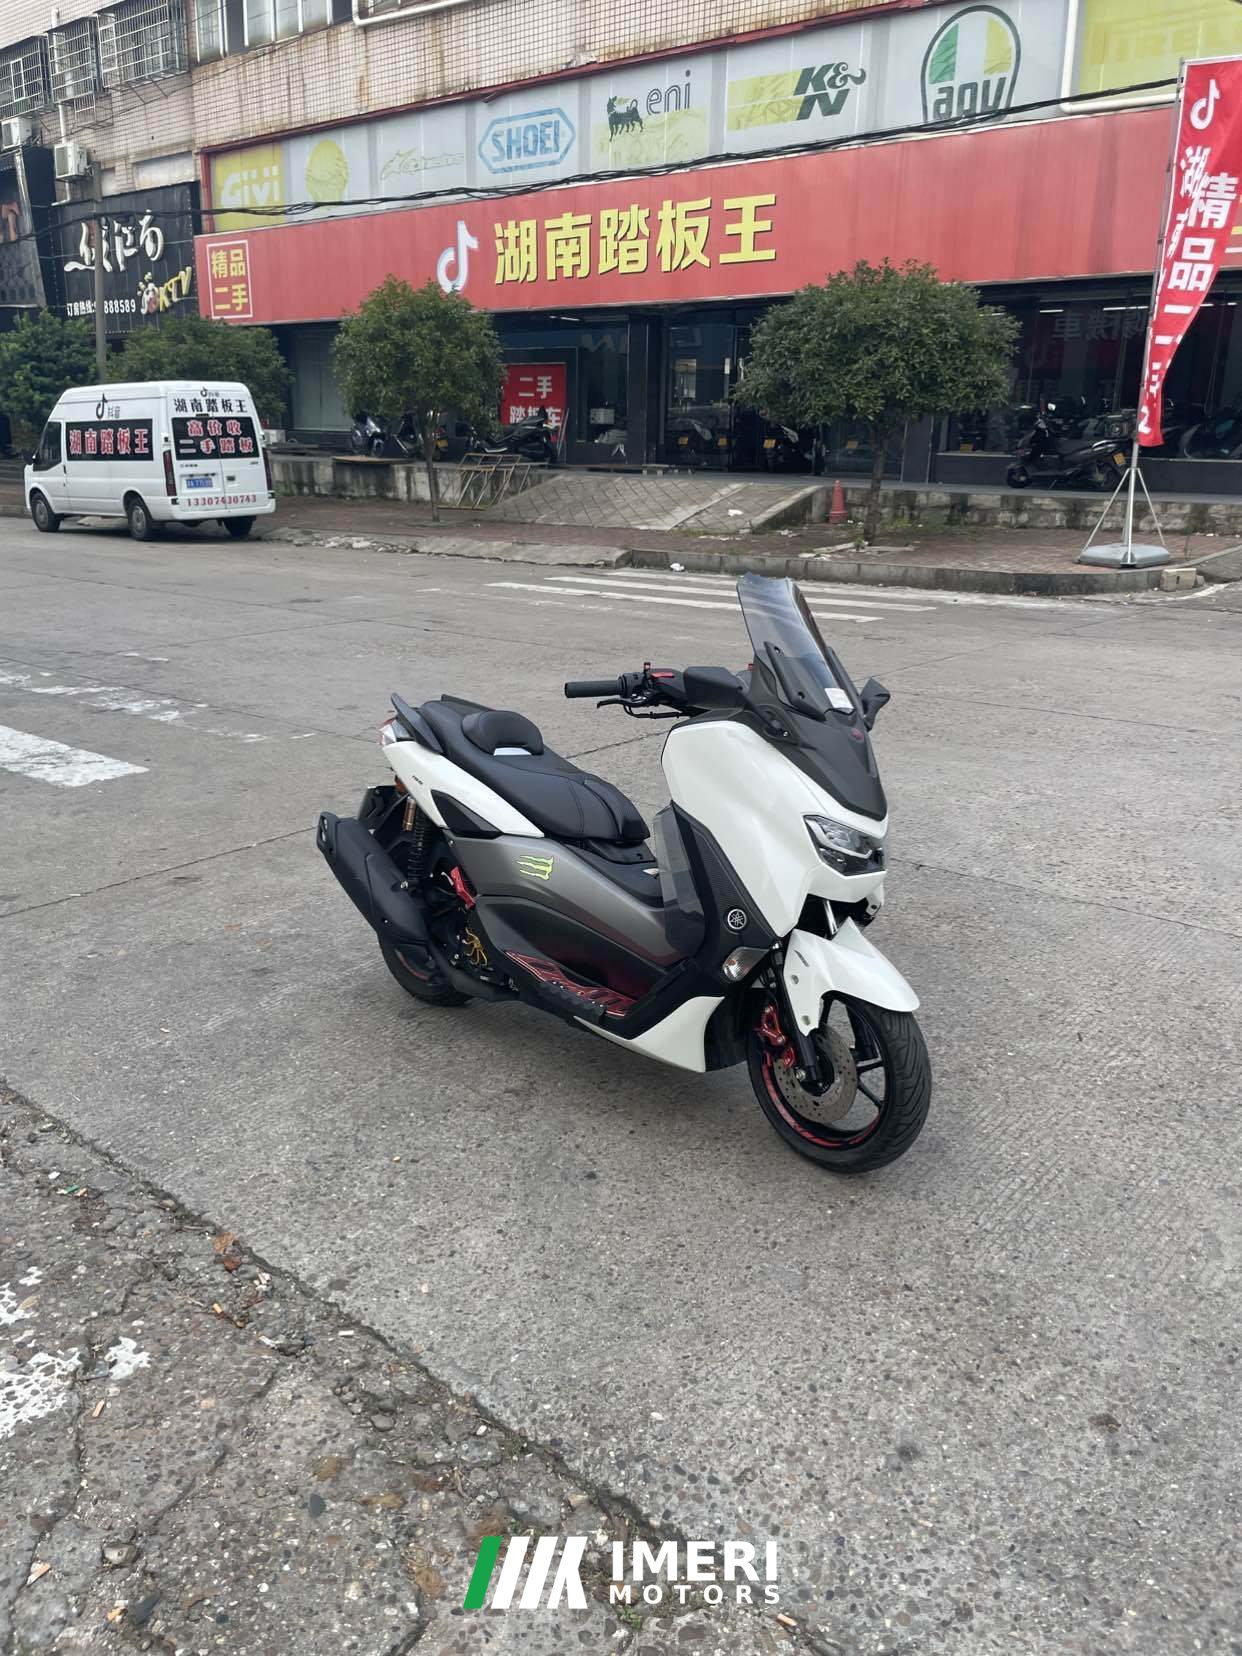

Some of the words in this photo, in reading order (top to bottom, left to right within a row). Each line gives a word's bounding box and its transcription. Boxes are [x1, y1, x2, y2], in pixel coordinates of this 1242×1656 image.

[646, 69, 692, 116] eni
[490, 119, 561, 163] SHOEI
[494, 194, 777, 285] 湖南踏板王
[210, 248, 246, 279] 精品
[159, 266, 192, 312] KTV
[214, 283, 249, 312] 二手
[518, 375, 553, 400] 二手
[174, 398, 248, 414] 湖南踏板王
[69, 427, 150, 455] 湖南踏板王
[187, 419, 243, 437] 高价收
[179, 438, 255, 455] 二手踏板
